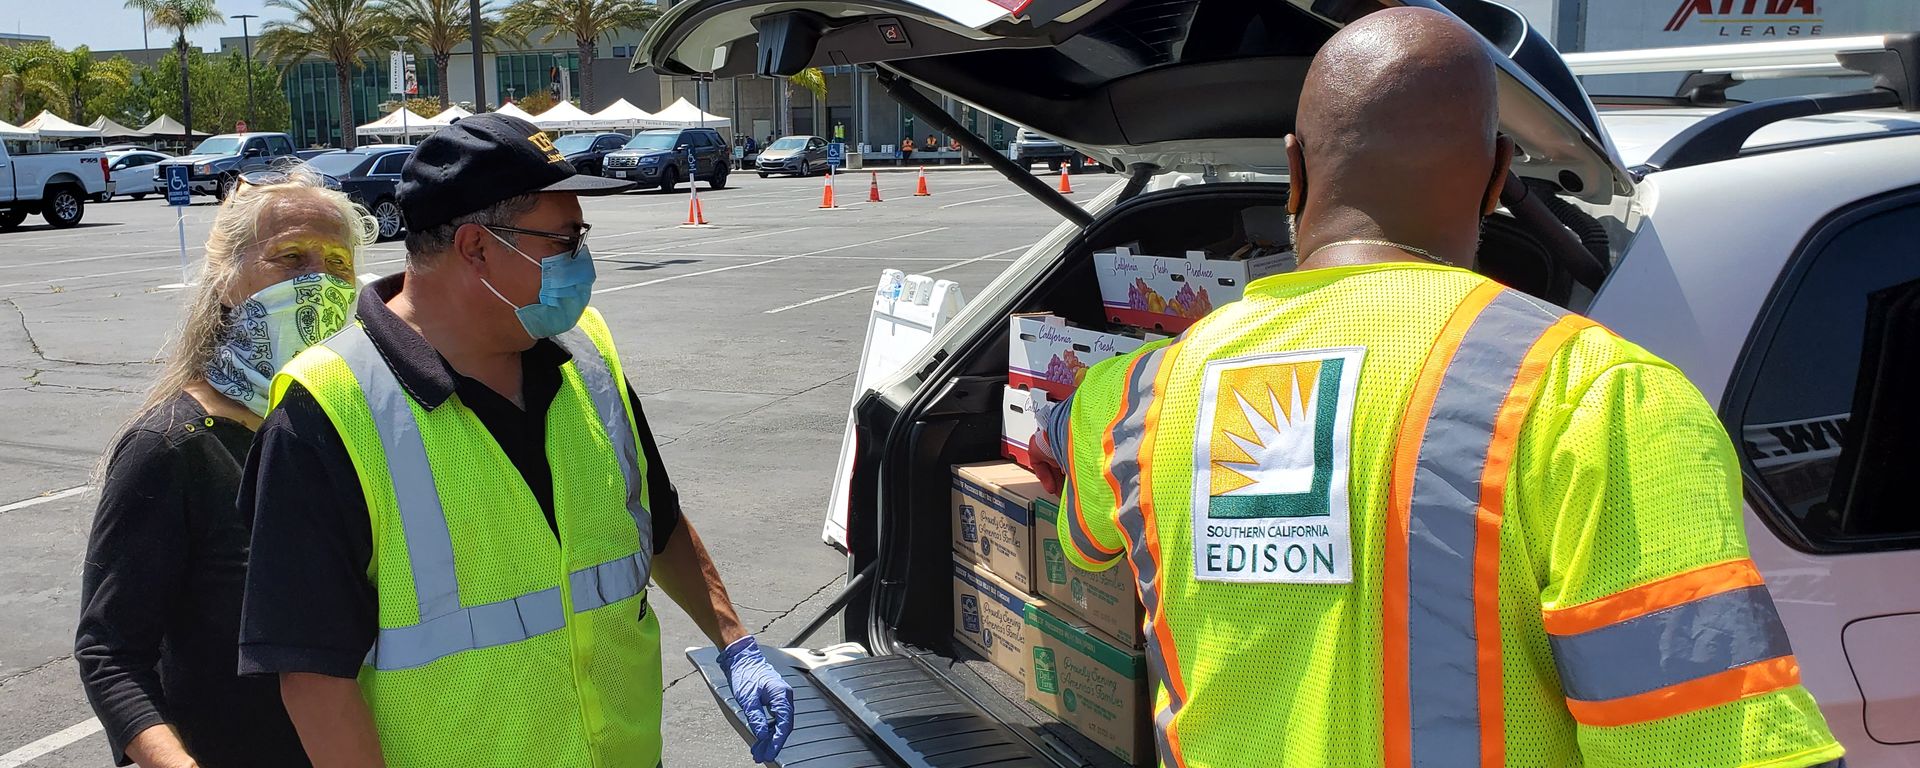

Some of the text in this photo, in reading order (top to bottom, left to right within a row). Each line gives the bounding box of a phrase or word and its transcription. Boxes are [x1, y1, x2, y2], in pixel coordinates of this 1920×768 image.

[1719, 25, 1824, 37] LEASE
[1112, 258, 1214, 279] California Fresh Produce
[1038, 324, 1116, 352] California Fresh
[1207, 525, 1329, 538] SOUTHERN CALIFORNIA
[1207, 543, 1335, 574] EDISON
